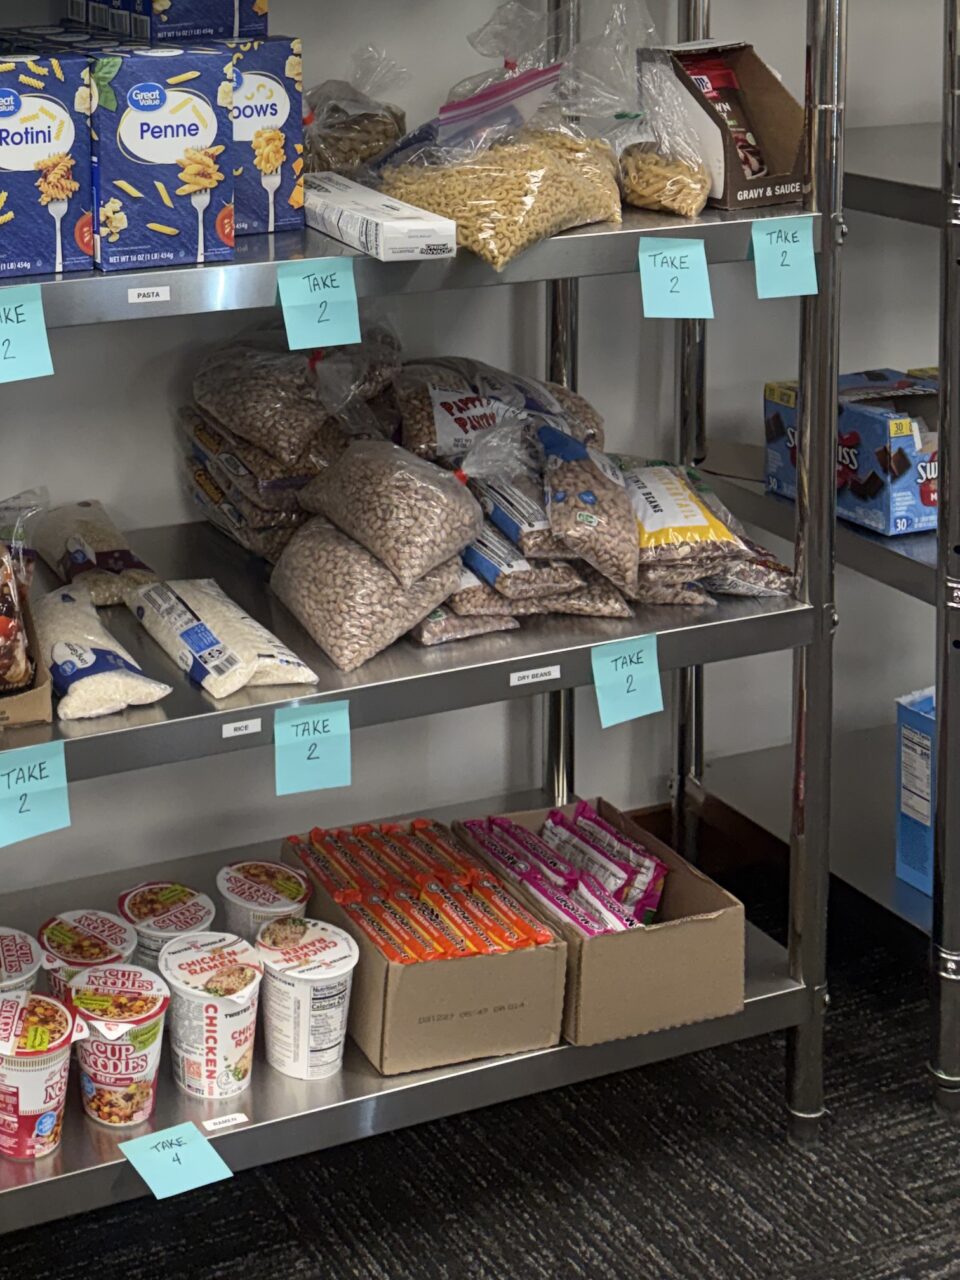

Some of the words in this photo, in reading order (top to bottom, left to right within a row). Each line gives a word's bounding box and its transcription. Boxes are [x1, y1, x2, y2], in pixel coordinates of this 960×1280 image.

[132, 89, 160, 100] Great
[139, 98, 160, 106] Value
[140, 122, 199, 140] Penne
[737, 187, 765, 201] GRAVY
[766, 186, 772, 196] &
[774, 182, 801, 196] SAUCE
[766, 230, 800, 244] TAKE
[648, 252, 690, 270] TAKE
[780, 250, 791, 268] 2
[302, 272, 340, 291] TAKE
[670, 276, 680, 294] 2
[137, 290, 160, 299] PASTA
[317, 300, 330, 325] 2
[1, 338, 17, 362] 2
[896, 519, 907, 531] 30
[611, 651, 644, 671] TAKE
[531, 671, 552, 679] BEANS
[626, 674, 636, 694] 2
[233, 724, 249, 733] RICE
[292, 719, 331, 738] TAKE
[306, 742, 321, 761] 2
[0, 760, 51, 788] TAKE
[18, 793, 32, 815] 2
[75, 915, 125, 947] NOODLES
[0, 934, 21, 974] NOODLES
[17, 941, 33, 965] CUP
[281, 937, 327, 956] RAMEN
[284, 940, 337, 963] CHICKEN
[177, 950, 237, 970] CHICKEN
[188, 958, 238, 976] RAMEN
[87, 975, 154, 991] NOODLES
[104, 970, 142, 981] CUP
[224, 1005, 250, 1019] TWISTED
[91, 1043, 136, 1059] CUP
[204, 1004, 218, 1080] CHICKEN
[81, 1054, 148, 1075] NOODLES
[213, 1117, 238, 1127] RAMEN
[150, 1136, 188, 1154] TAKE
[172, 1154, 182, 1165] 4
